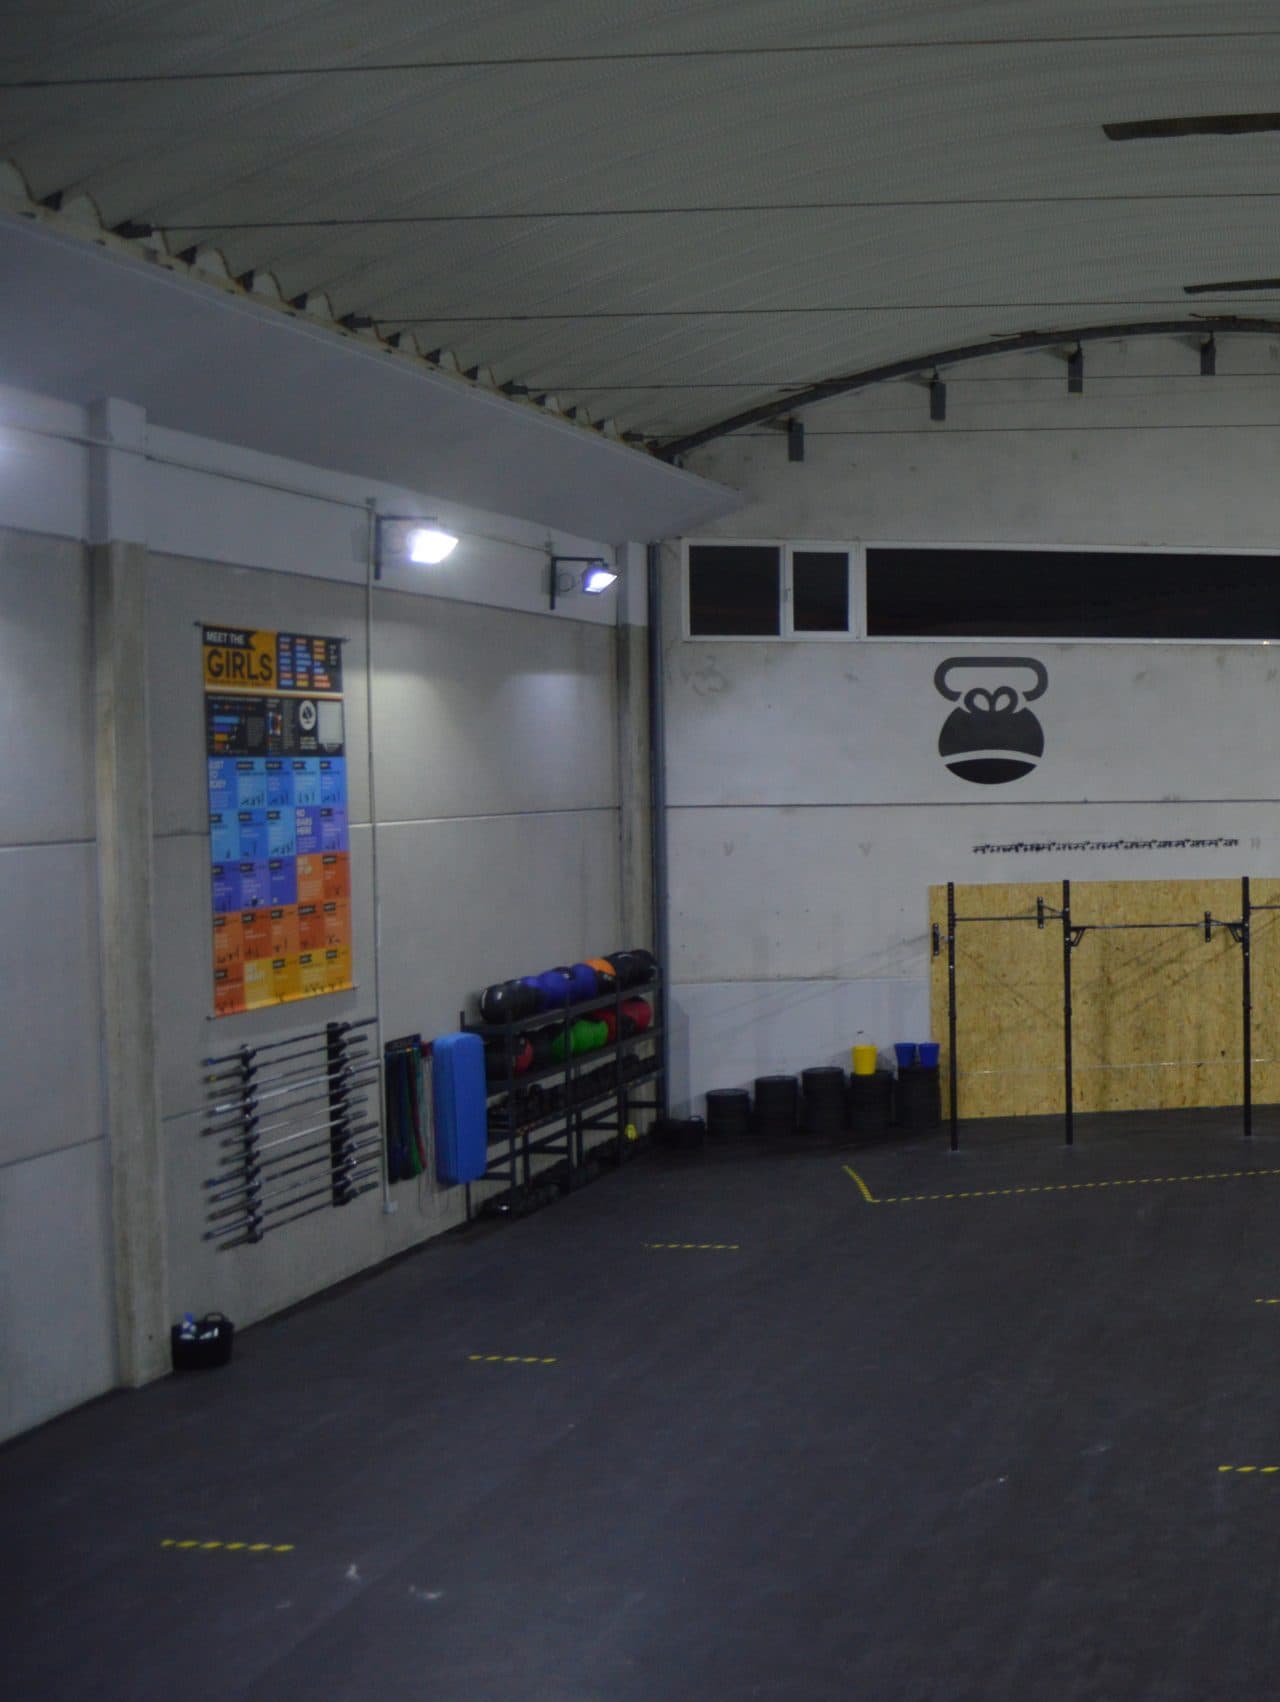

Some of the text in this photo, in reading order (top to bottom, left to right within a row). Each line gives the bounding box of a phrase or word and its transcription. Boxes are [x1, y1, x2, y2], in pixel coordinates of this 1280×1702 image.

[206, 631, 245, 645] MEET THE
[207, 648, 273, 681] GIRLS
